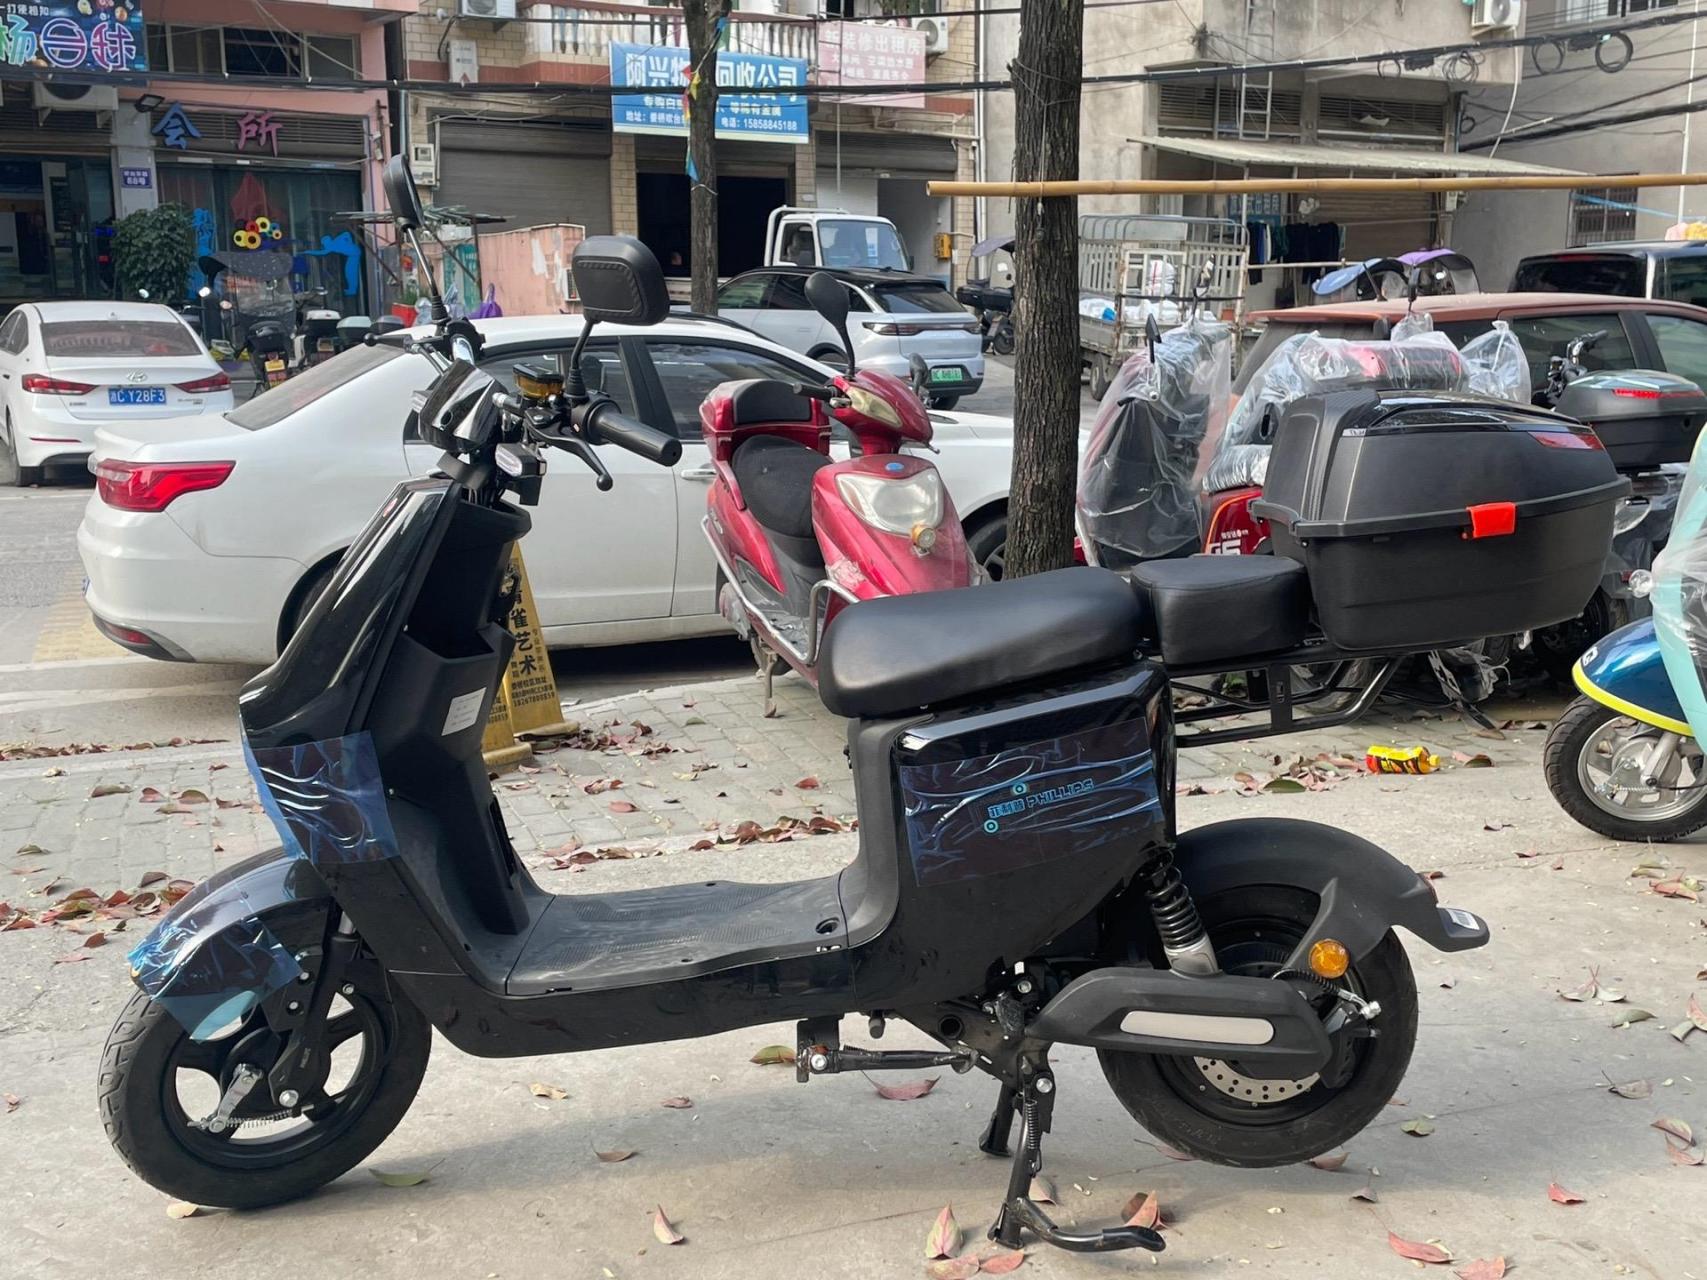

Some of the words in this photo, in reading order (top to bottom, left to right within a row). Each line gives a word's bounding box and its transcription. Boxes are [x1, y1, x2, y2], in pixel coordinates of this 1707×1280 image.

[151, 103, 283, 158] 会所
[511, 589, 537, 675] 雀艺术
[1026, 779, 1094, 808] PHILLIPS
